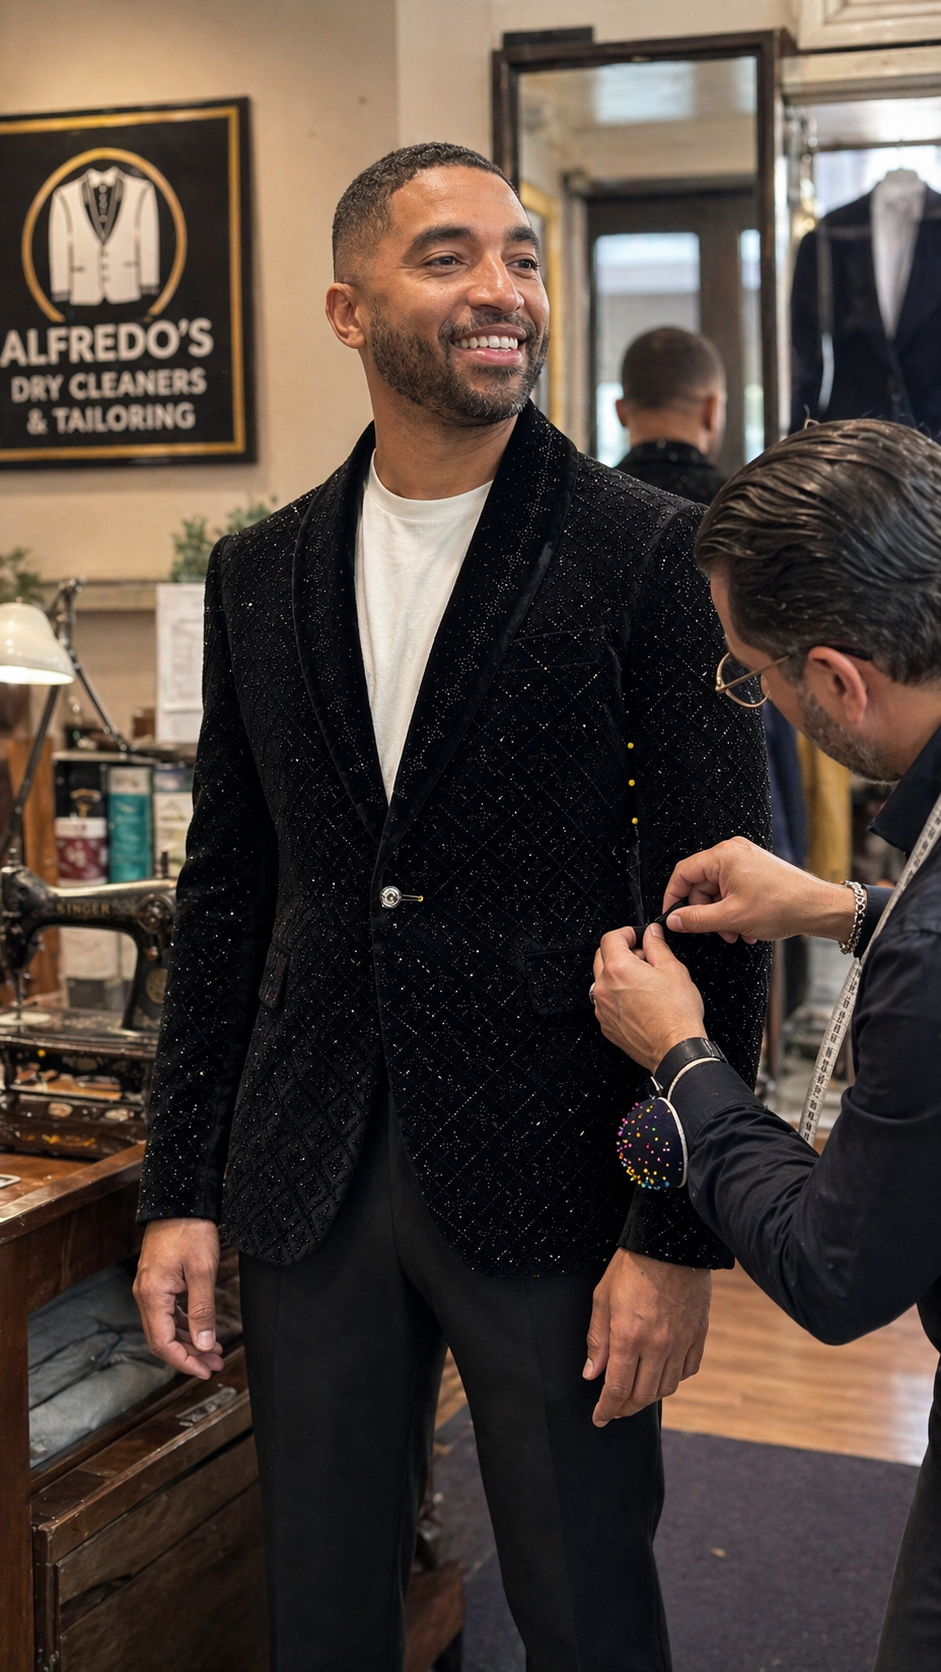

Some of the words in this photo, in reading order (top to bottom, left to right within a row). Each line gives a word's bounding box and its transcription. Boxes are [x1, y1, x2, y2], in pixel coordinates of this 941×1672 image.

[0, 317, 214, 368] ALFREDO'S
[11, 375, 64, 402] DRY
[68, 367, 207, 401] CLEANERS
[26, 408, 49, 435] &
[52, 402, 196, 434] TAILORING
